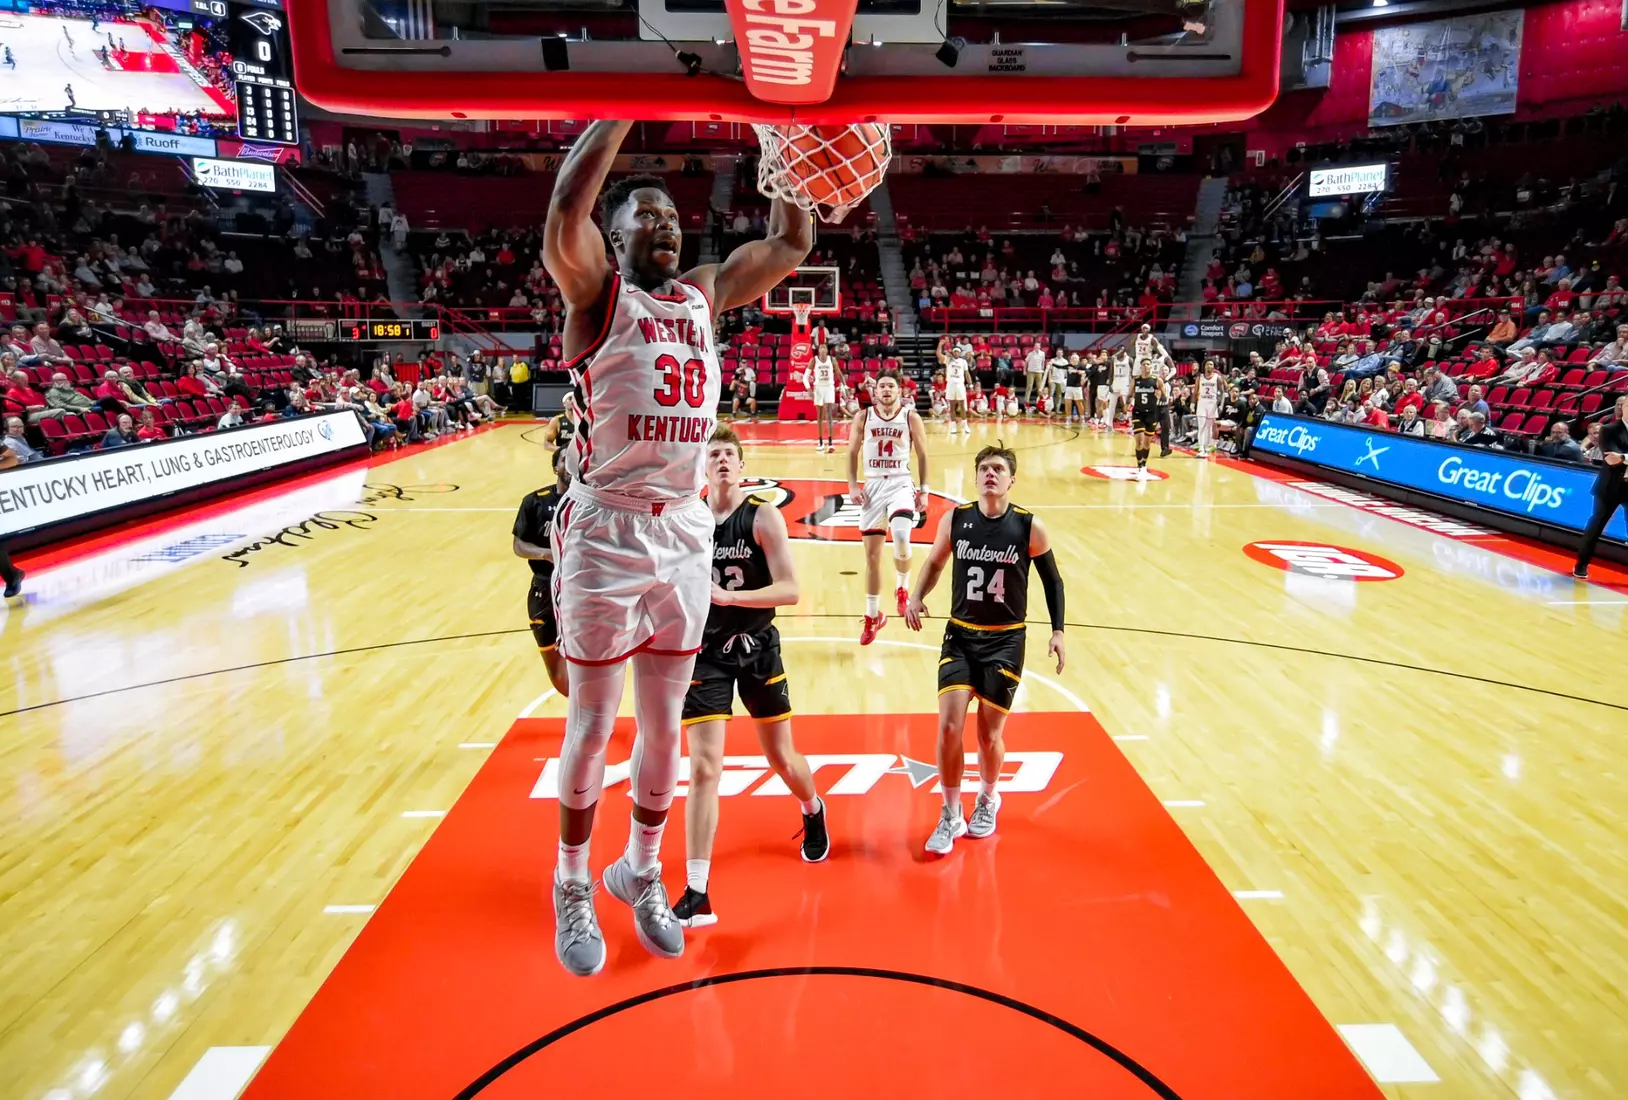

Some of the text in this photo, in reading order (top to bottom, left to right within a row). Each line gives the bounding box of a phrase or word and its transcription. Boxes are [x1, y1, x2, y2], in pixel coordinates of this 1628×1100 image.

[258, 41, 271, 61] 0
[145, 137, 180, 149] Ruoff
[240, 146, 279, 158] Budweiser
[248, 180, 267, 188] 2284
[352, 327, 359, 340] 3
[374, 325, 401, 336] 18:58
[430, 327, 438, 339] 0
[654, 354, 706, 408] 30
[1141, 393, 1148, 404] 5
[871, 427, 903, 439] WESTERN
[1256, 419, 1319, 455] Great Clips
[878, 440, 893, 457] 14
[869, 459, 901, 468] KENTUCKY
[0, 429, 315, 514] ENTUCKY HEART, LUNG & GASTROENTEROLOGY
[1438, 456, 1566, 512] Great Clips
[713, 539, 752, 560] tevallo
[956, 539, 1019, 565] Montevallo
[966, 566, 1005, 603] 24
